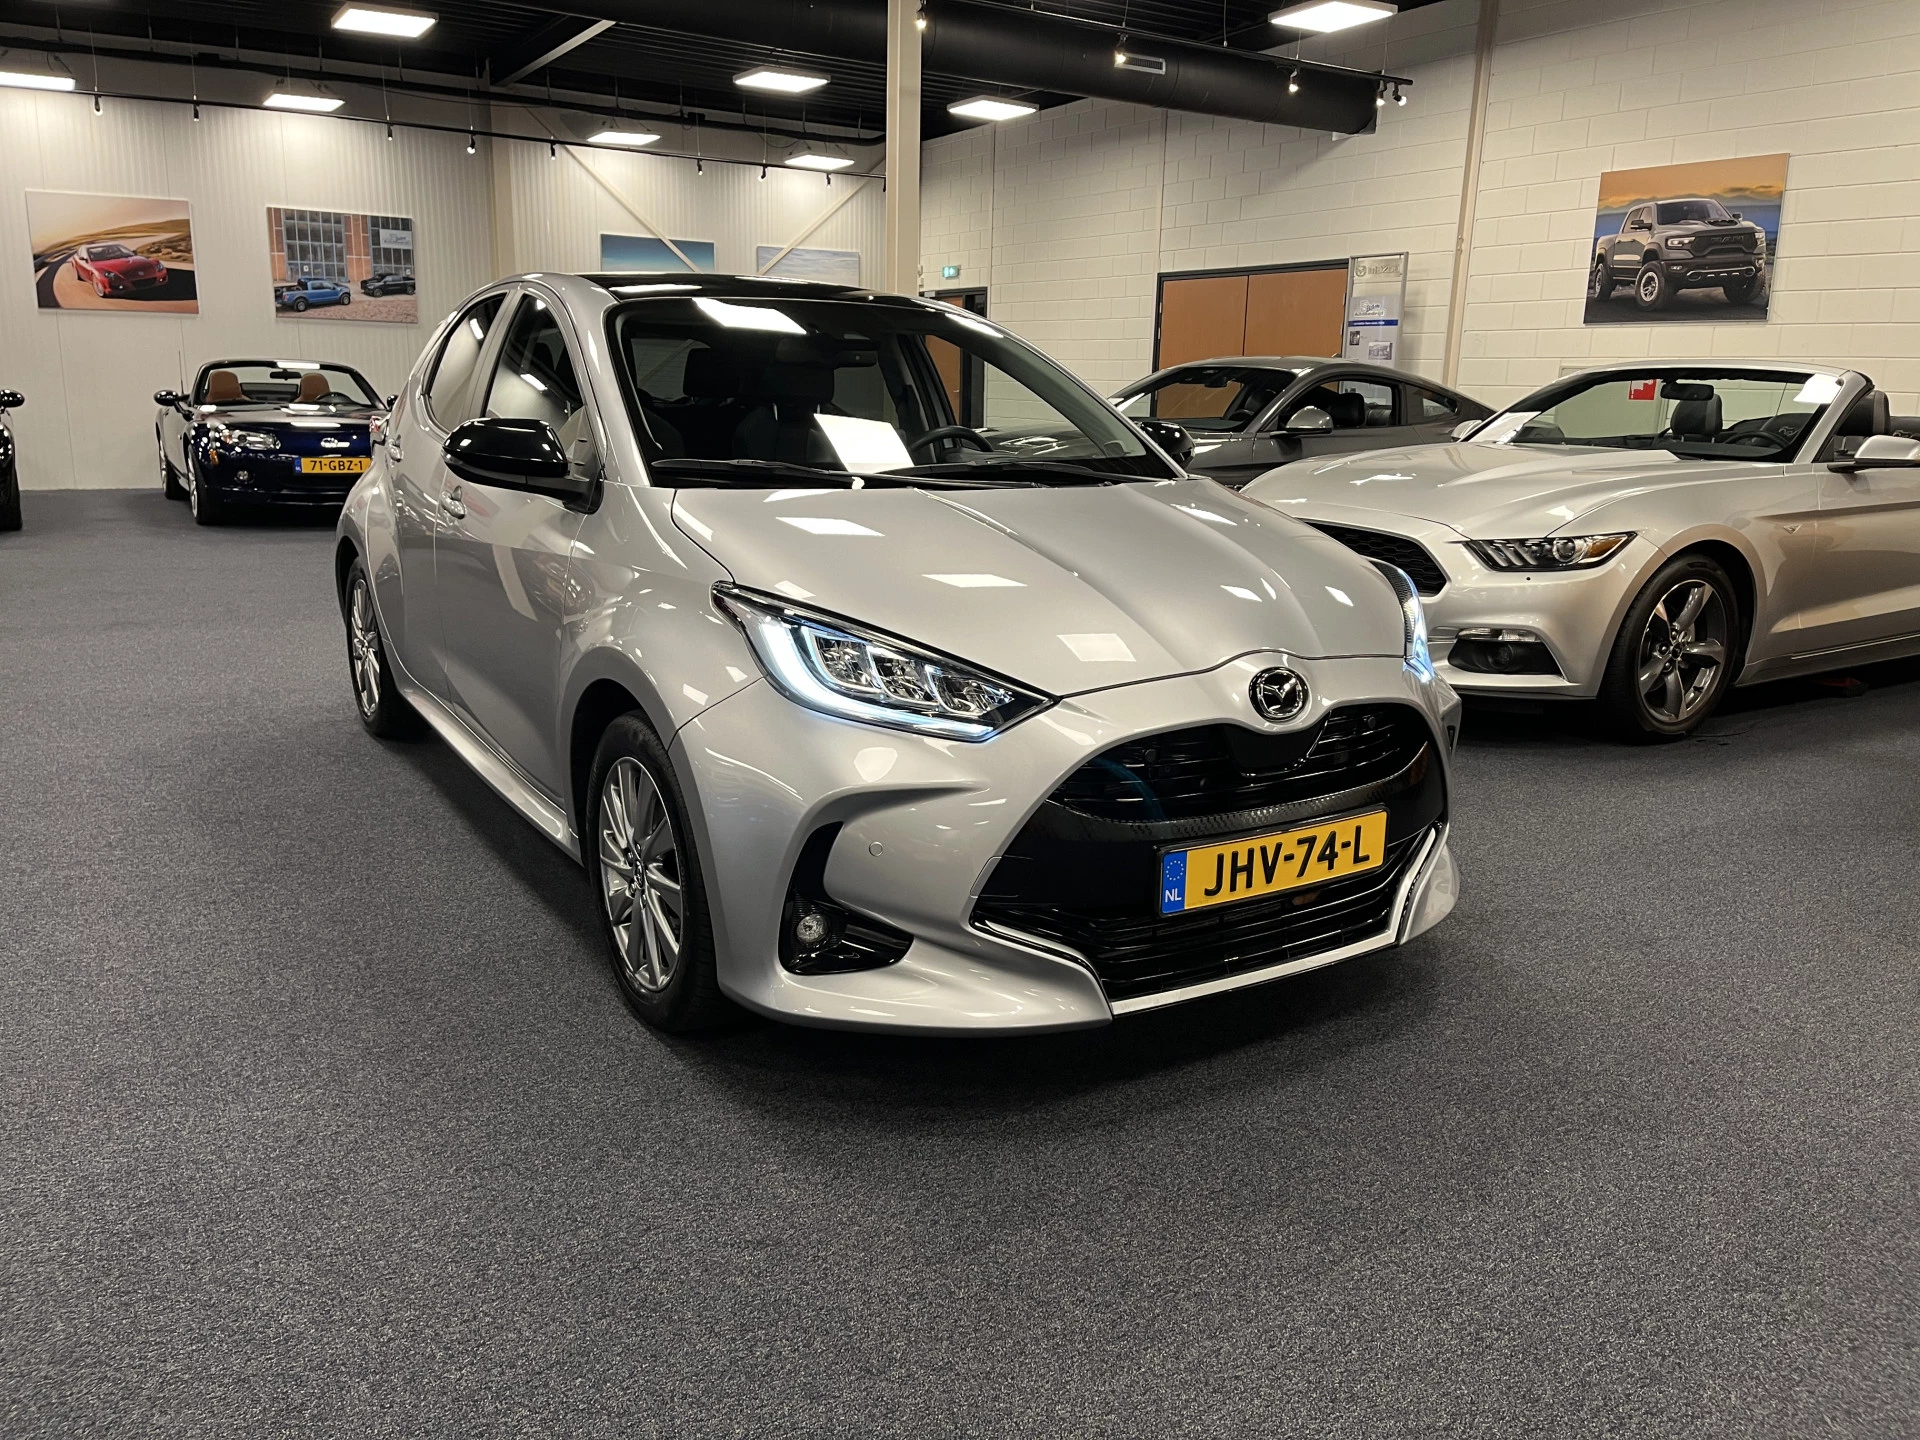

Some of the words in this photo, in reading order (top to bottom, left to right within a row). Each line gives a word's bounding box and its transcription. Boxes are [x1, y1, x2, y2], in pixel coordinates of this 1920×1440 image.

[310, 460, 363, 471] 71-GBZ-1
[1204, 825, 1370, 896] JHV-74-L
[1165, 888, 1182, 902] NL
